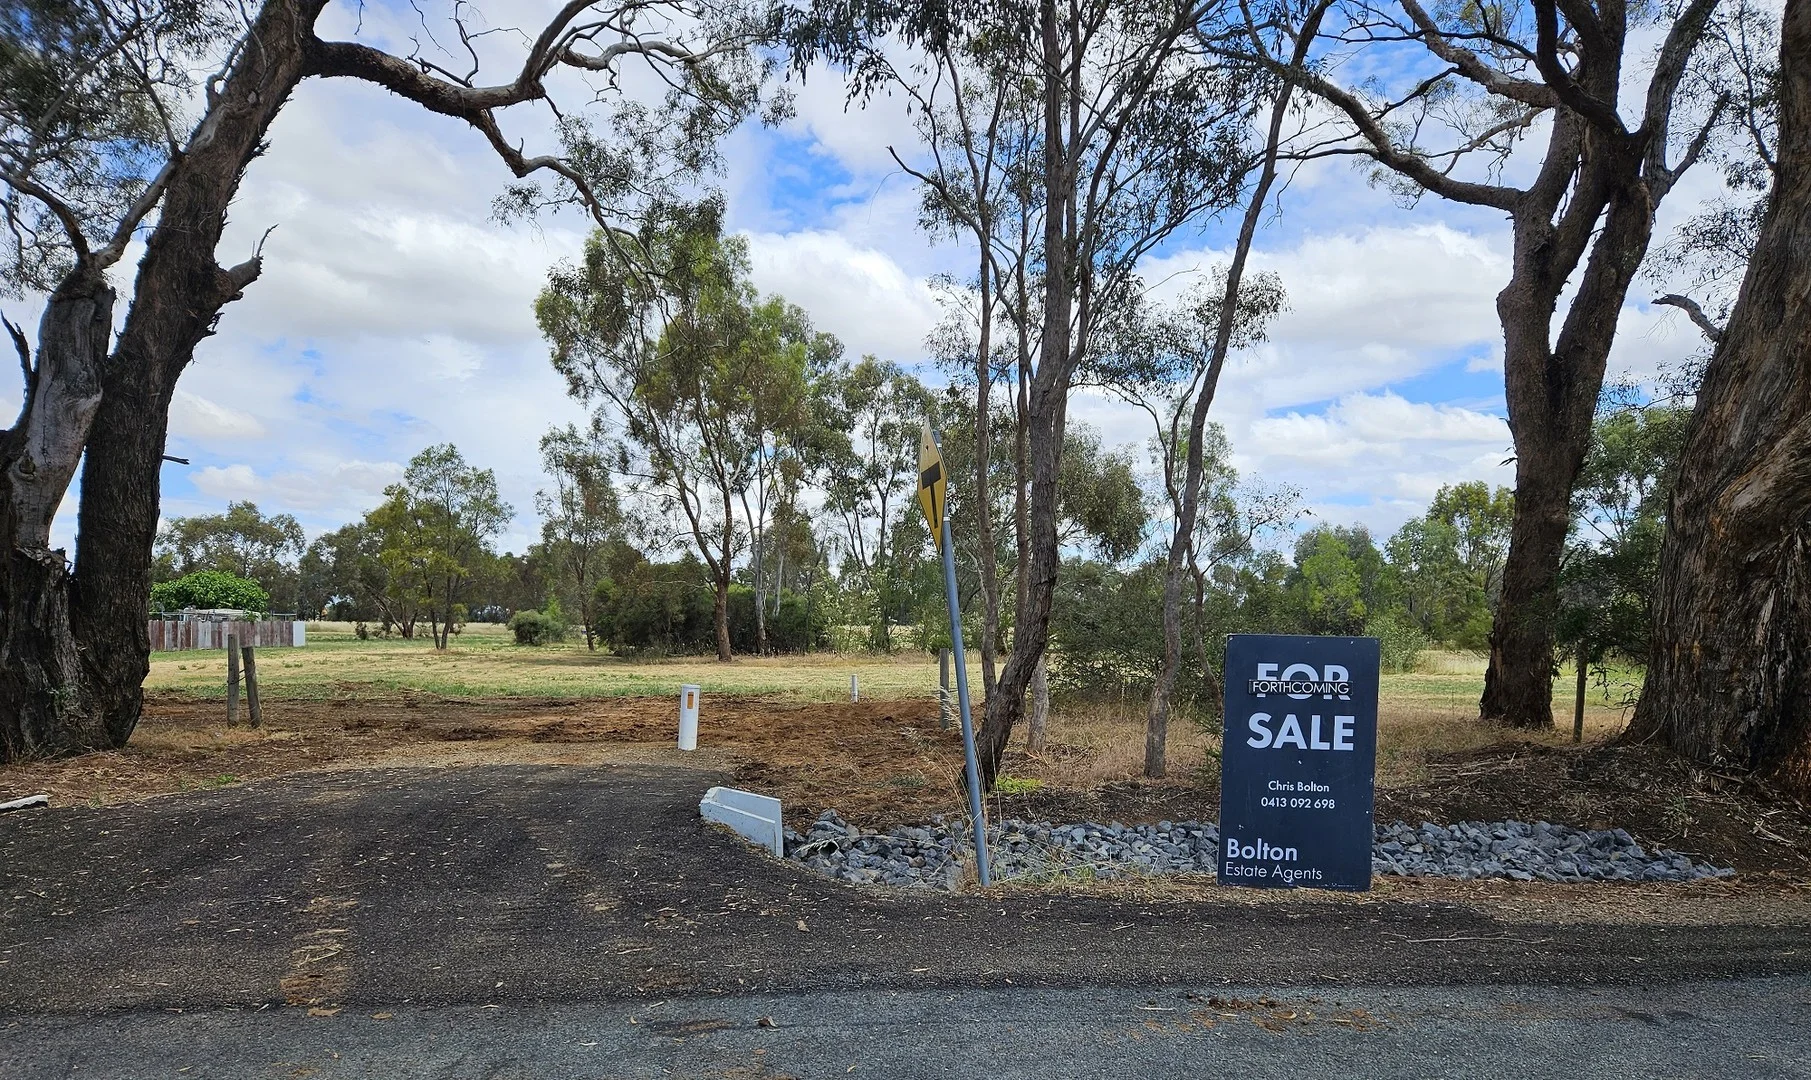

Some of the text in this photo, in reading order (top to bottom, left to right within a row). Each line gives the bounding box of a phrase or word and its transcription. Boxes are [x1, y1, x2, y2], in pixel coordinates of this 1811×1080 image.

[1252, 681, 1350, 695] FORTHCOMING
[1257, 663, 1351, 700] FOR
[1247, 712, 1355, 751] SALE
[1268, 780, 1330, 792] Chris Bolton
[1260, 797, 1335, 809] 0413 092 698
[1226, 838, 1298, 861] Bolton
[1225, 862, 1323, 883] Estate Agents
